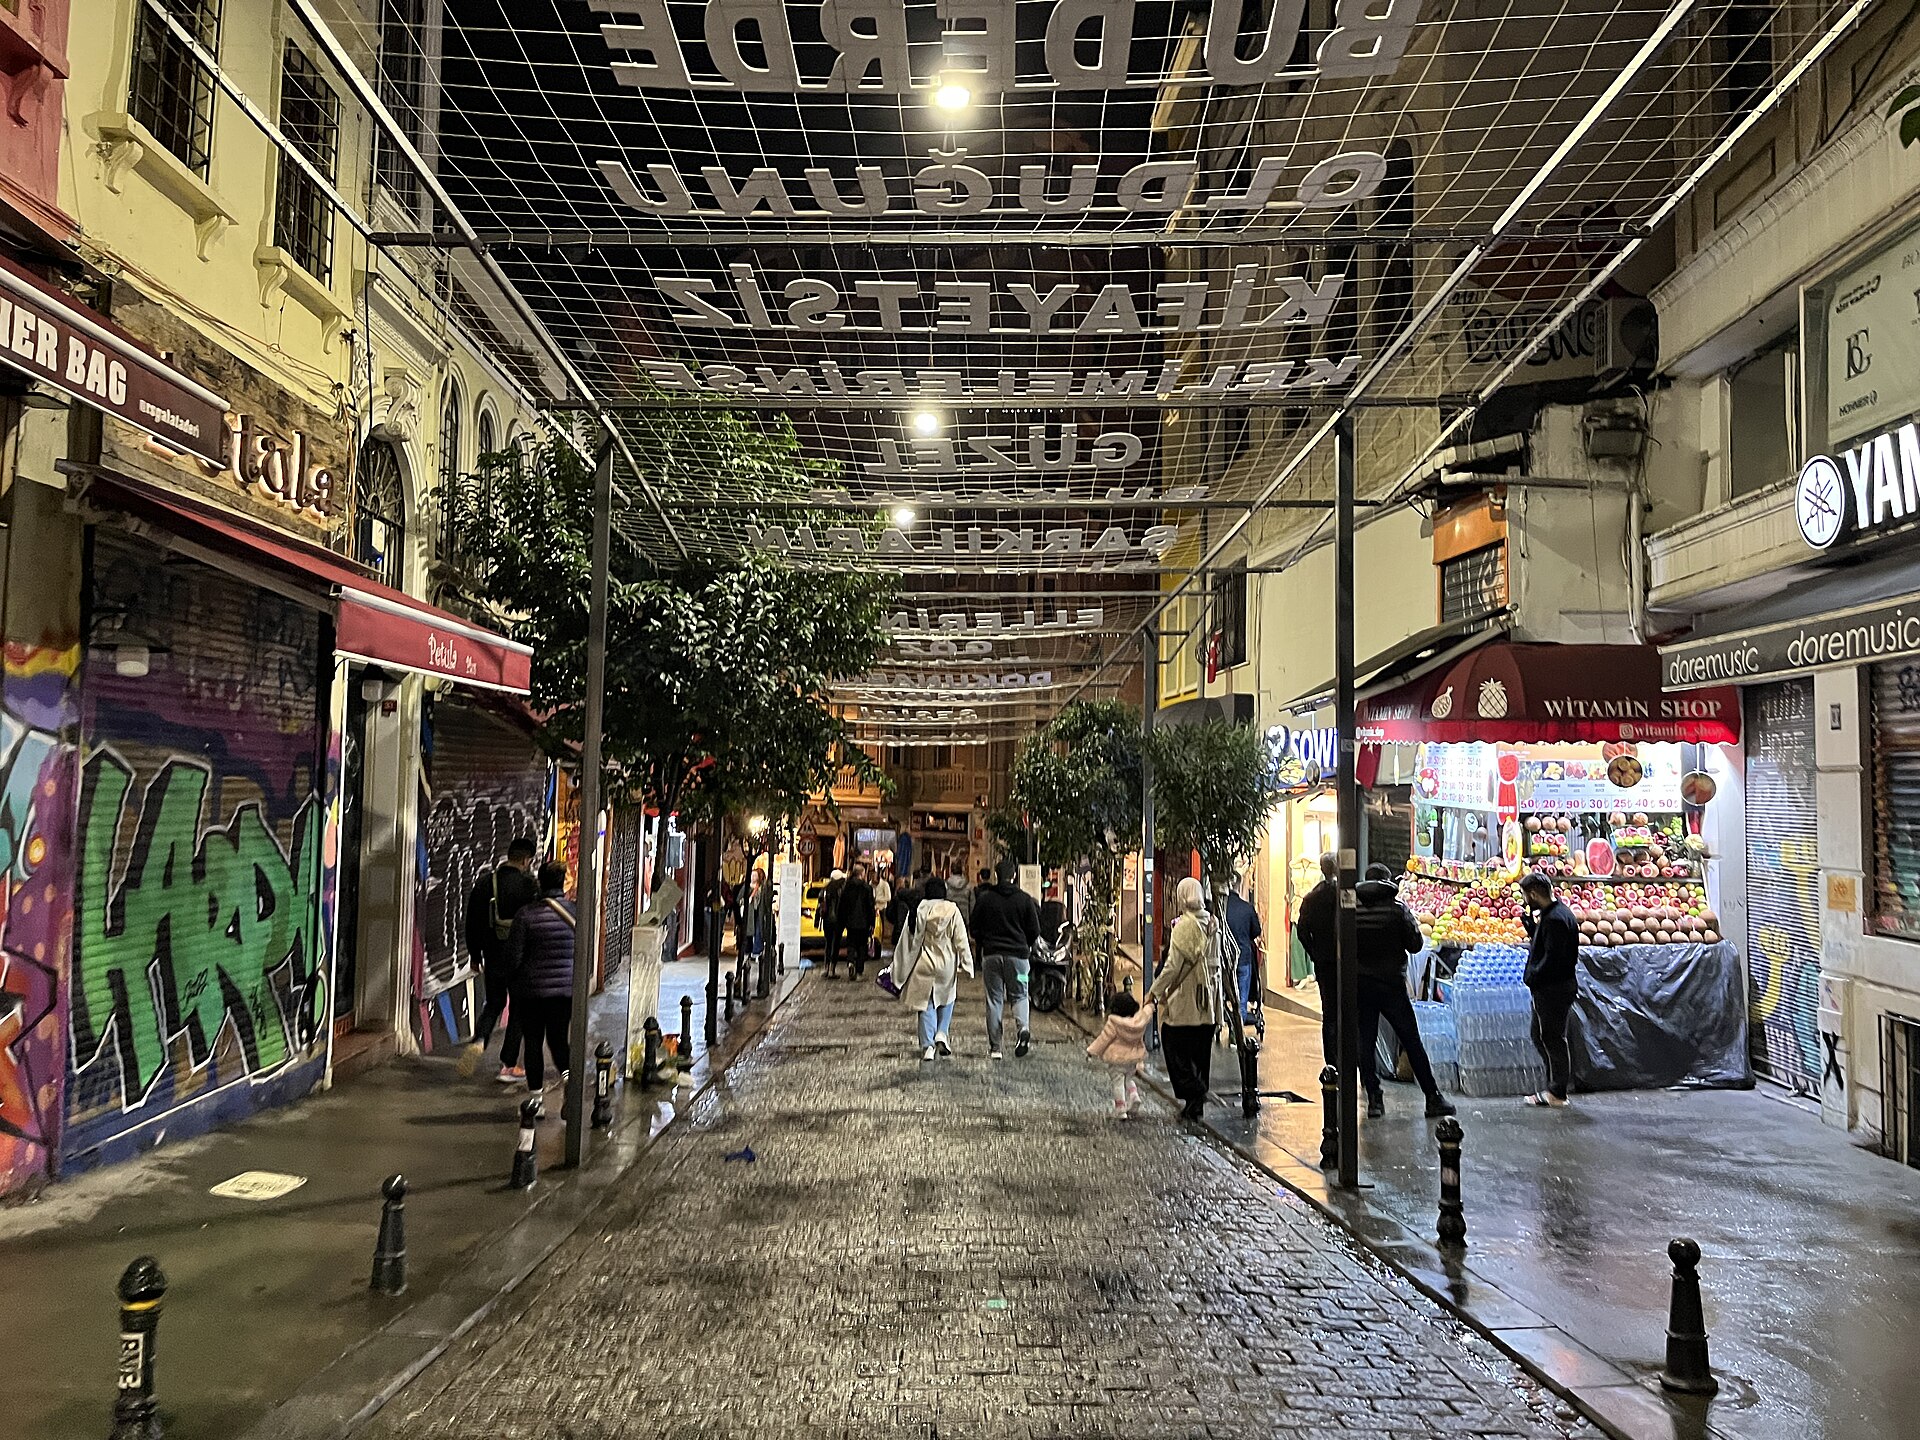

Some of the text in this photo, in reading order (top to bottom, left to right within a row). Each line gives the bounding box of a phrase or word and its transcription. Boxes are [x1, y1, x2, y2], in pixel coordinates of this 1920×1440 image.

[65, 336, 127, 406] BAG
[428, 633, 457, 670] Petula
[1668, 609, 1920, 685] doremusic doremusic
[1660, 699, 1722, 718] SHOP
